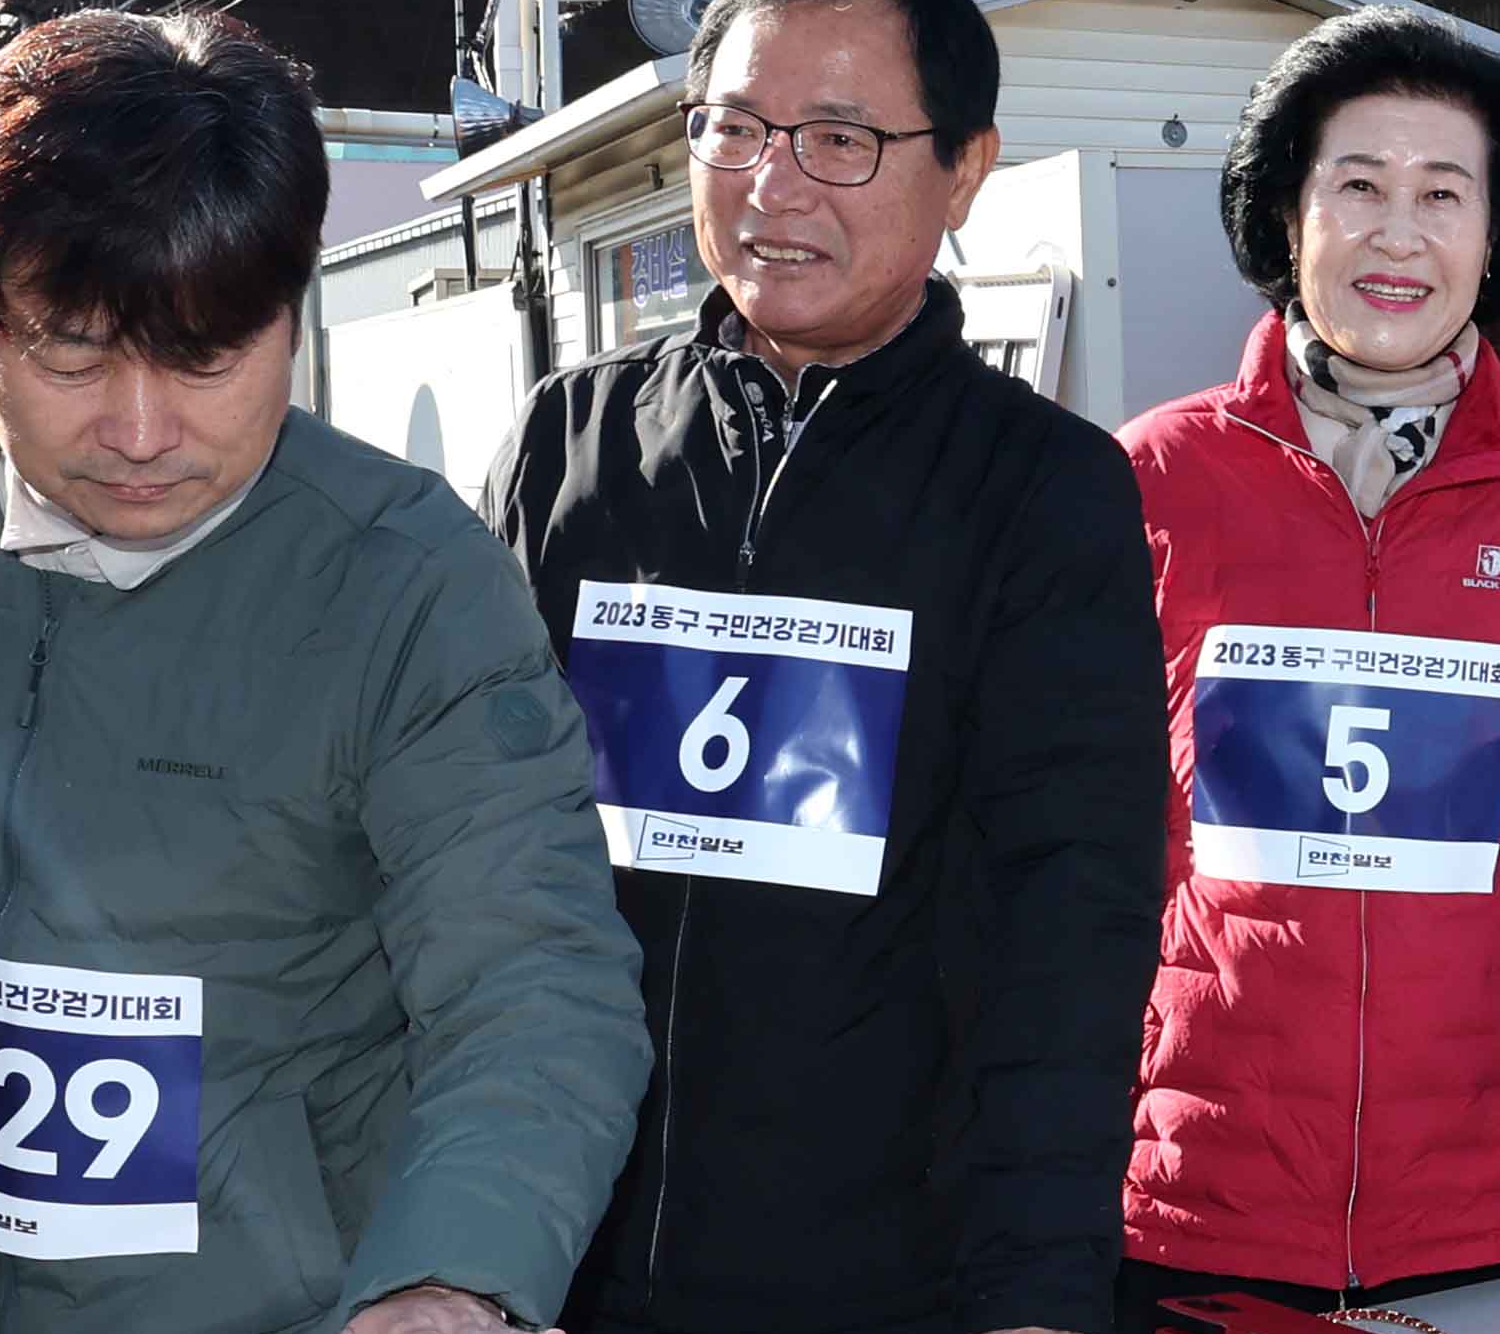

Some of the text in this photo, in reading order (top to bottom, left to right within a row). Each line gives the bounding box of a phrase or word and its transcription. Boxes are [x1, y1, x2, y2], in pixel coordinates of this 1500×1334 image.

[631, 227, 688, 307] 경비실
[592, 600, 895, 654] 2023 동구 구민건강걷기대회
[1213, 641, 1276, 667] 2023
[1281, 645, 1325, 671] 동구
[678, 675, 750, 793] 6
[1322, 704, 1391, 814] 5
[651, 831, 744, 854] 인천일보
[1308, 849, 1392, 870] 인천일보
